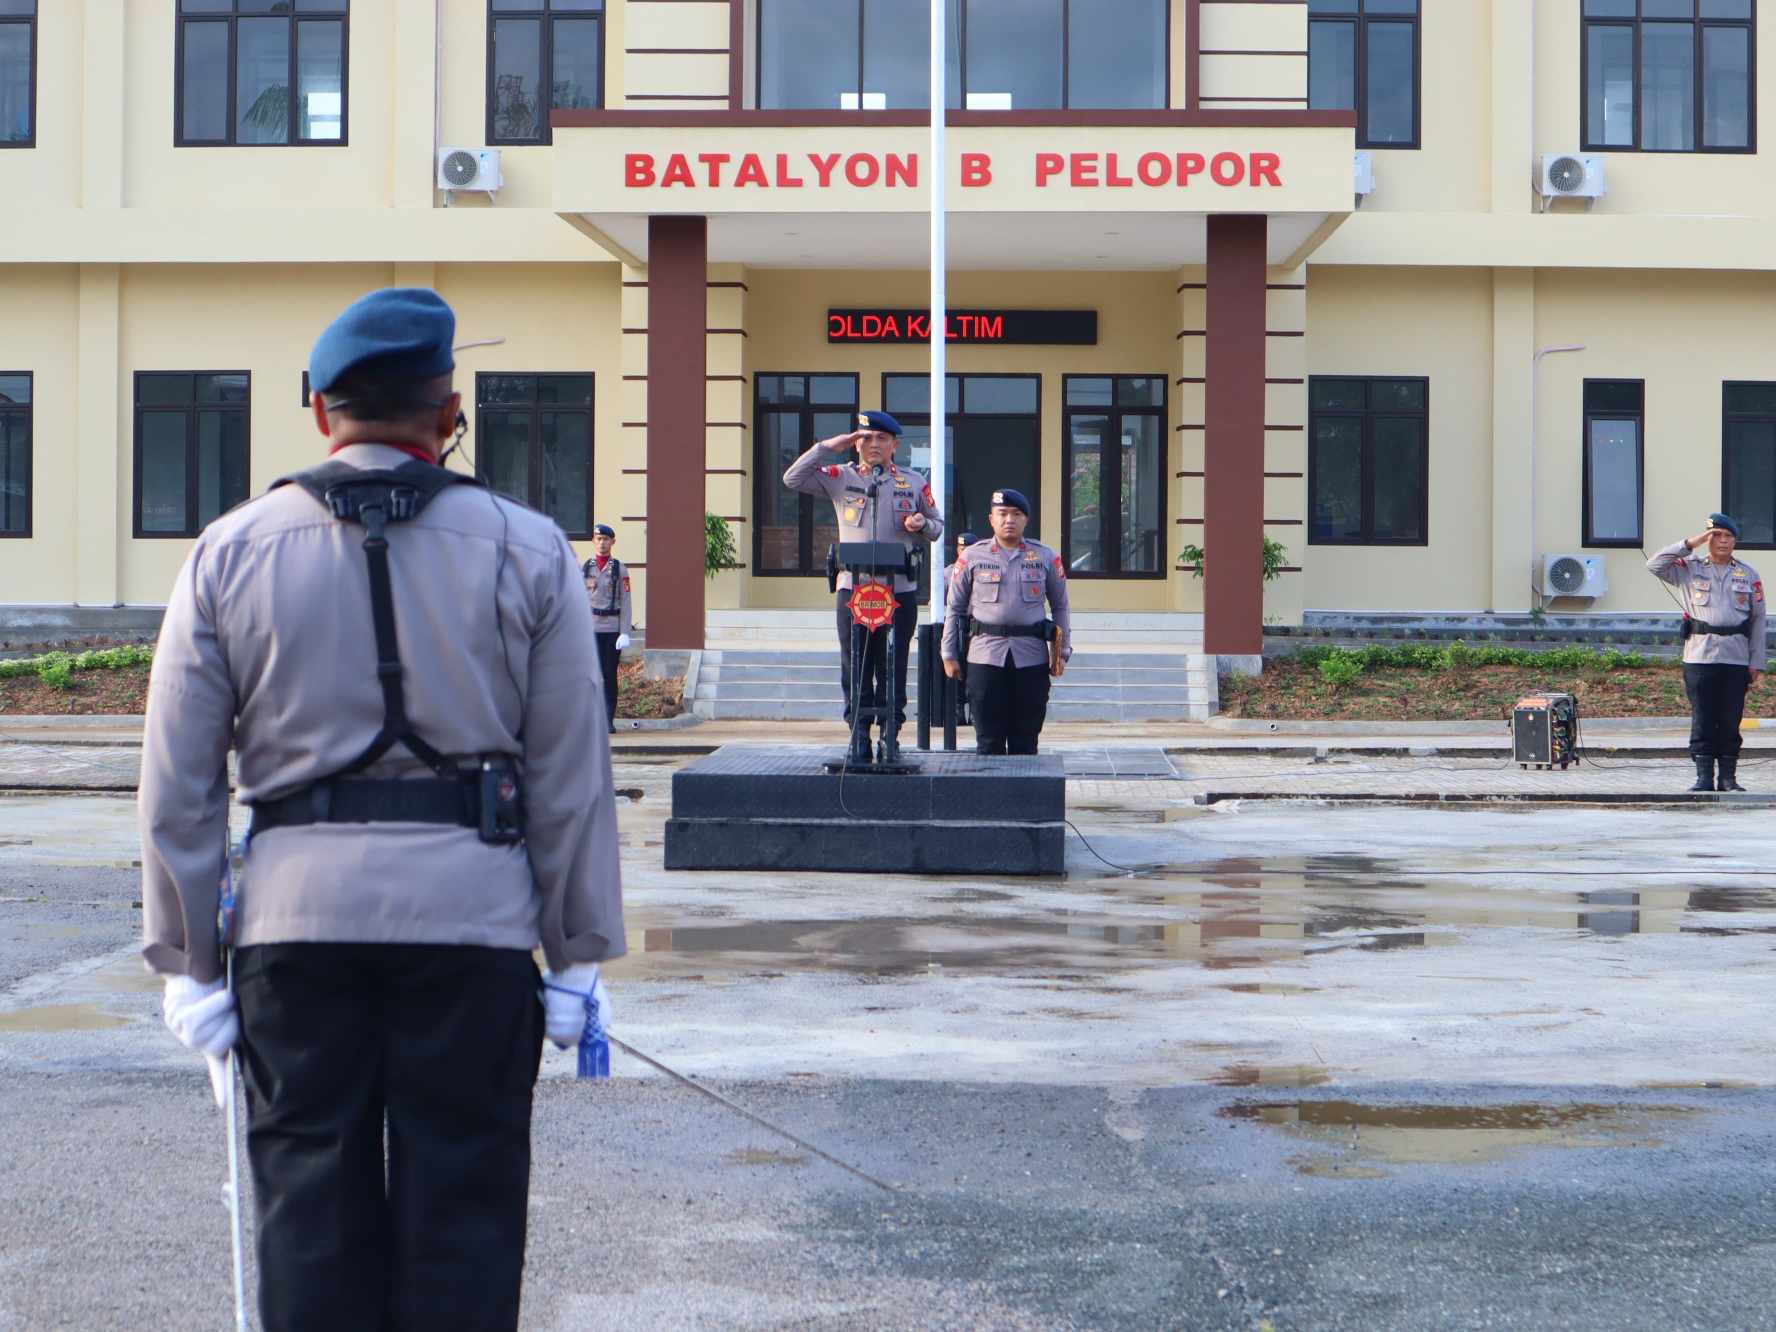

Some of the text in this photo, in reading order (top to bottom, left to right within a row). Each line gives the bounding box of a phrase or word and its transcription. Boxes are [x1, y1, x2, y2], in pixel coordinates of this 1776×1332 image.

[625, 152, 1281, 188] BATALYON B PELOPOR
